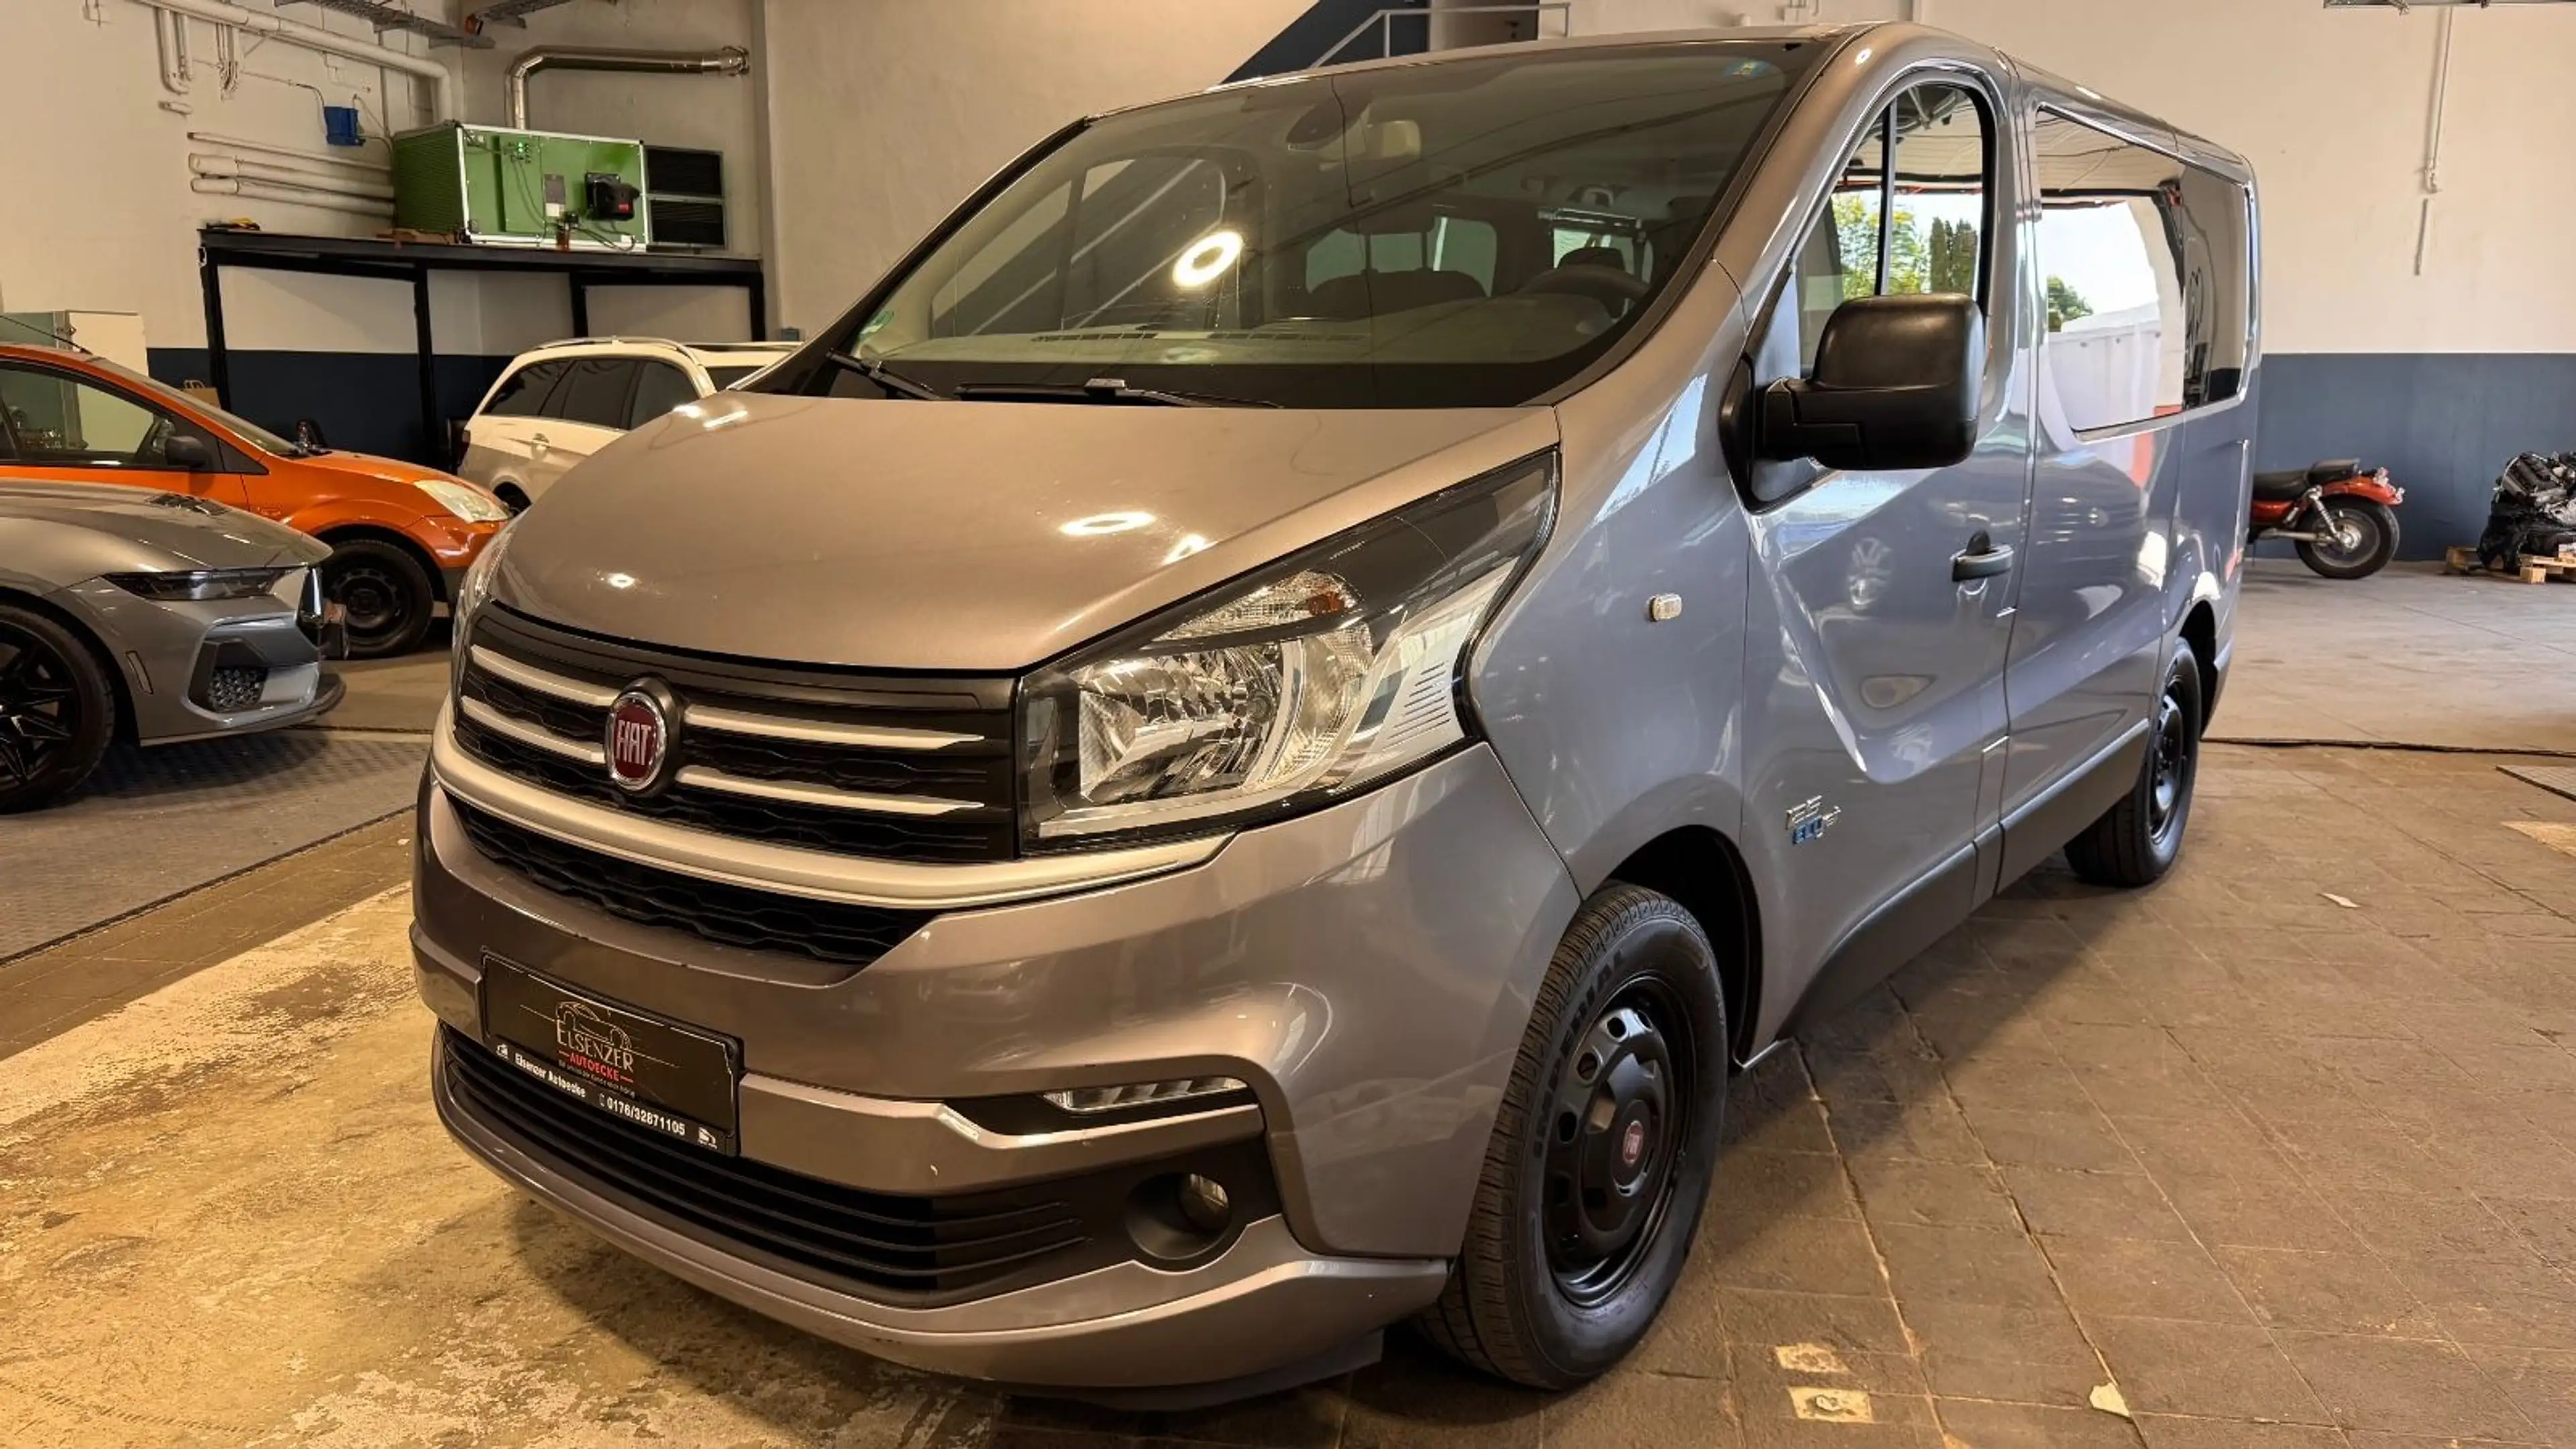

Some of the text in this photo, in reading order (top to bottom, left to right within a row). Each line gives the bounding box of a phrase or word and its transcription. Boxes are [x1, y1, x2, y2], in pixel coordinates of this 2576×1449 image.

[616, 719, 651, 766] FIAT
[555, 1018, 634, 1073] ELSENZER
[515, 1052, 547, 1079] Elsenzer
[569, 1051, 621, 1082] AUTOECKE
